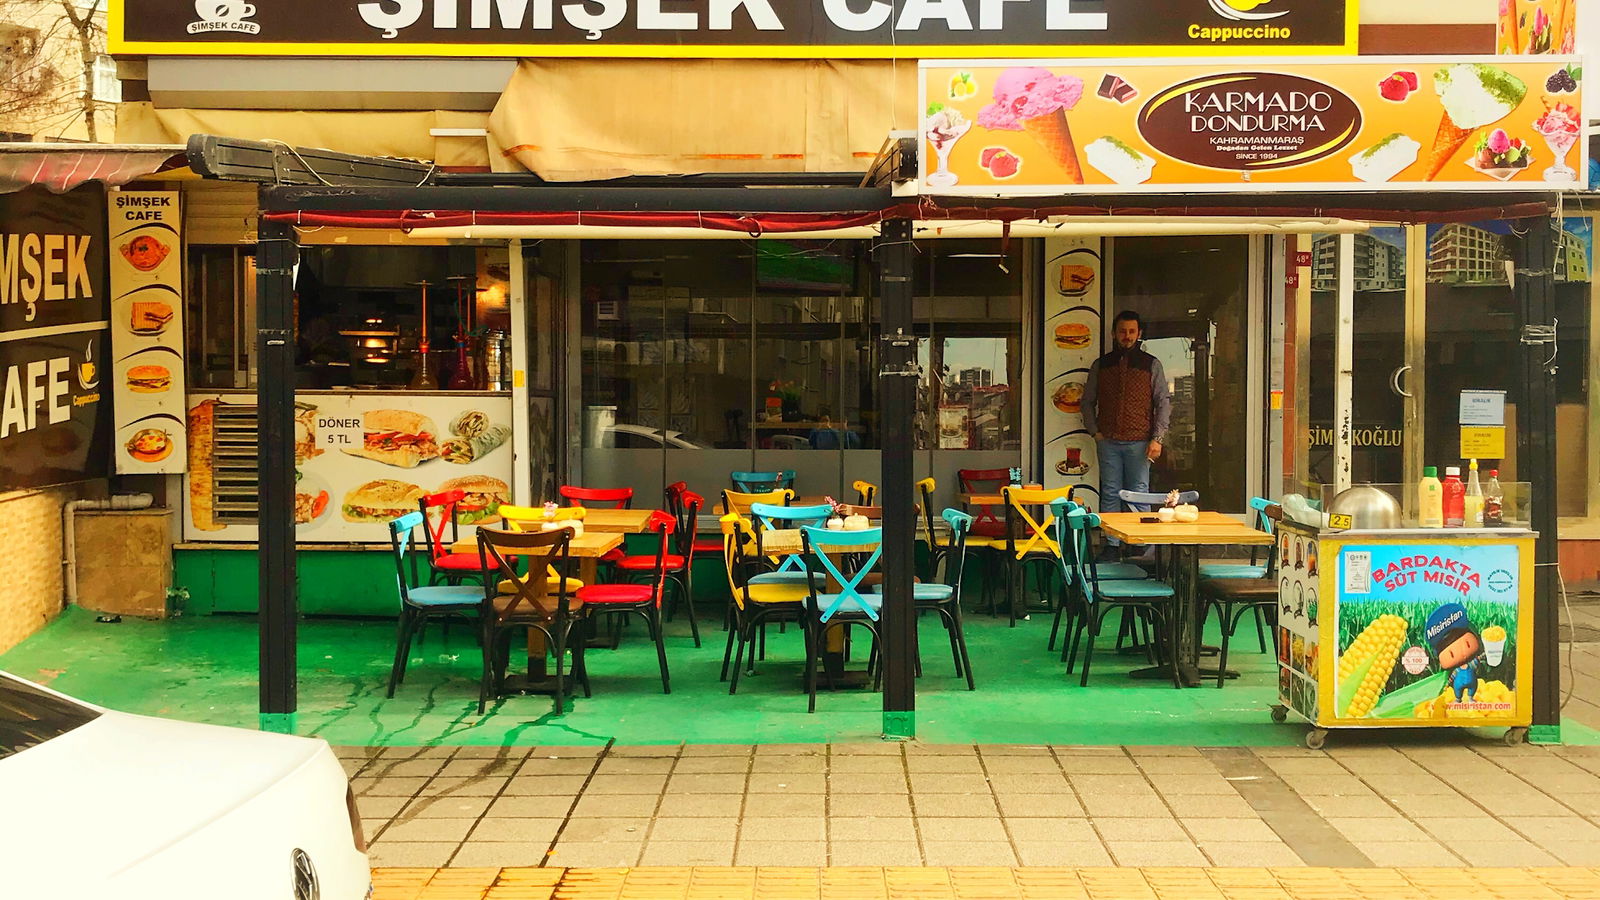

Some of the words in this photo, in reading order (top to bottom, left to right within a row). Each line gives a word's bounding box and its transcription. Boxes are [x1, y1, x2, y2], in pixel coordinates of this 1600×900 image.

[191, 21, 228, 32] ŞİMŞEK
[230, 22, 256, 32] CAFE
[1187, 24, 1291, 41] Cappuccino
[1185, 91, 1332, 112] KARMADO
[1191, 115, 1325, 131] DONDURMA
[116, 194, 170, 209] ŞİMŞEK
[125, 211, 162, 221] CAFE
[0, 356, 71, 439] AFE
[319, 416, 360, 428] DÖNER
[327, 434, 334, 444] 5
[337, 434, 351, 444] TL
[1308, 425, 1402, 450] ŞİMKOĞLU
[1372, 555, 1480, 588] BARDAKTA
[1385, 571, 1417, 592] SÜT
[1427, 610, 1463, 639] Misiristan
